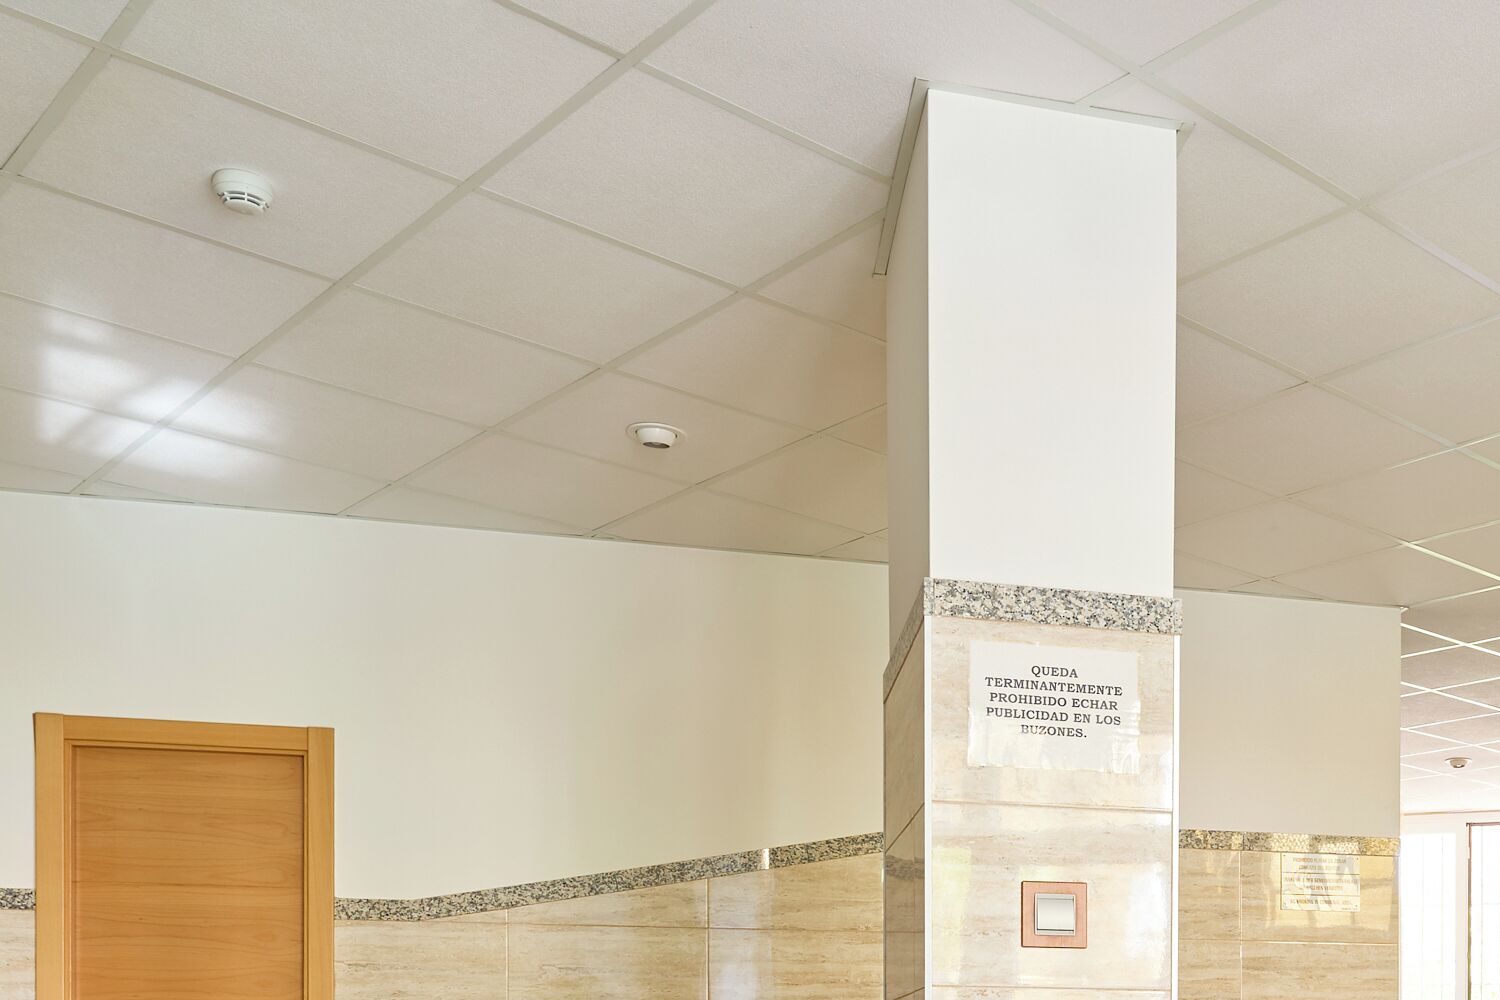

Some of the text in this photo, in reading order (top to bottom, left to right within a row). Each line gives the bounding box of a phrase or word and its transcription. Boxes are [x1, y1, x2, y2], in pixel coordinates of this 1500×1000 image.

[1031, 665, 1078, 678] QUEDA
[985, 677, 1123, 696] TERMINANTEMENTE
[990, 692, 1118, 710] PROHIBIDO ECHAR
[986, 707, 1121, 725] PUBLICIDAD EN LOS
[1021, 725, 1087, 738] BUZONES.
